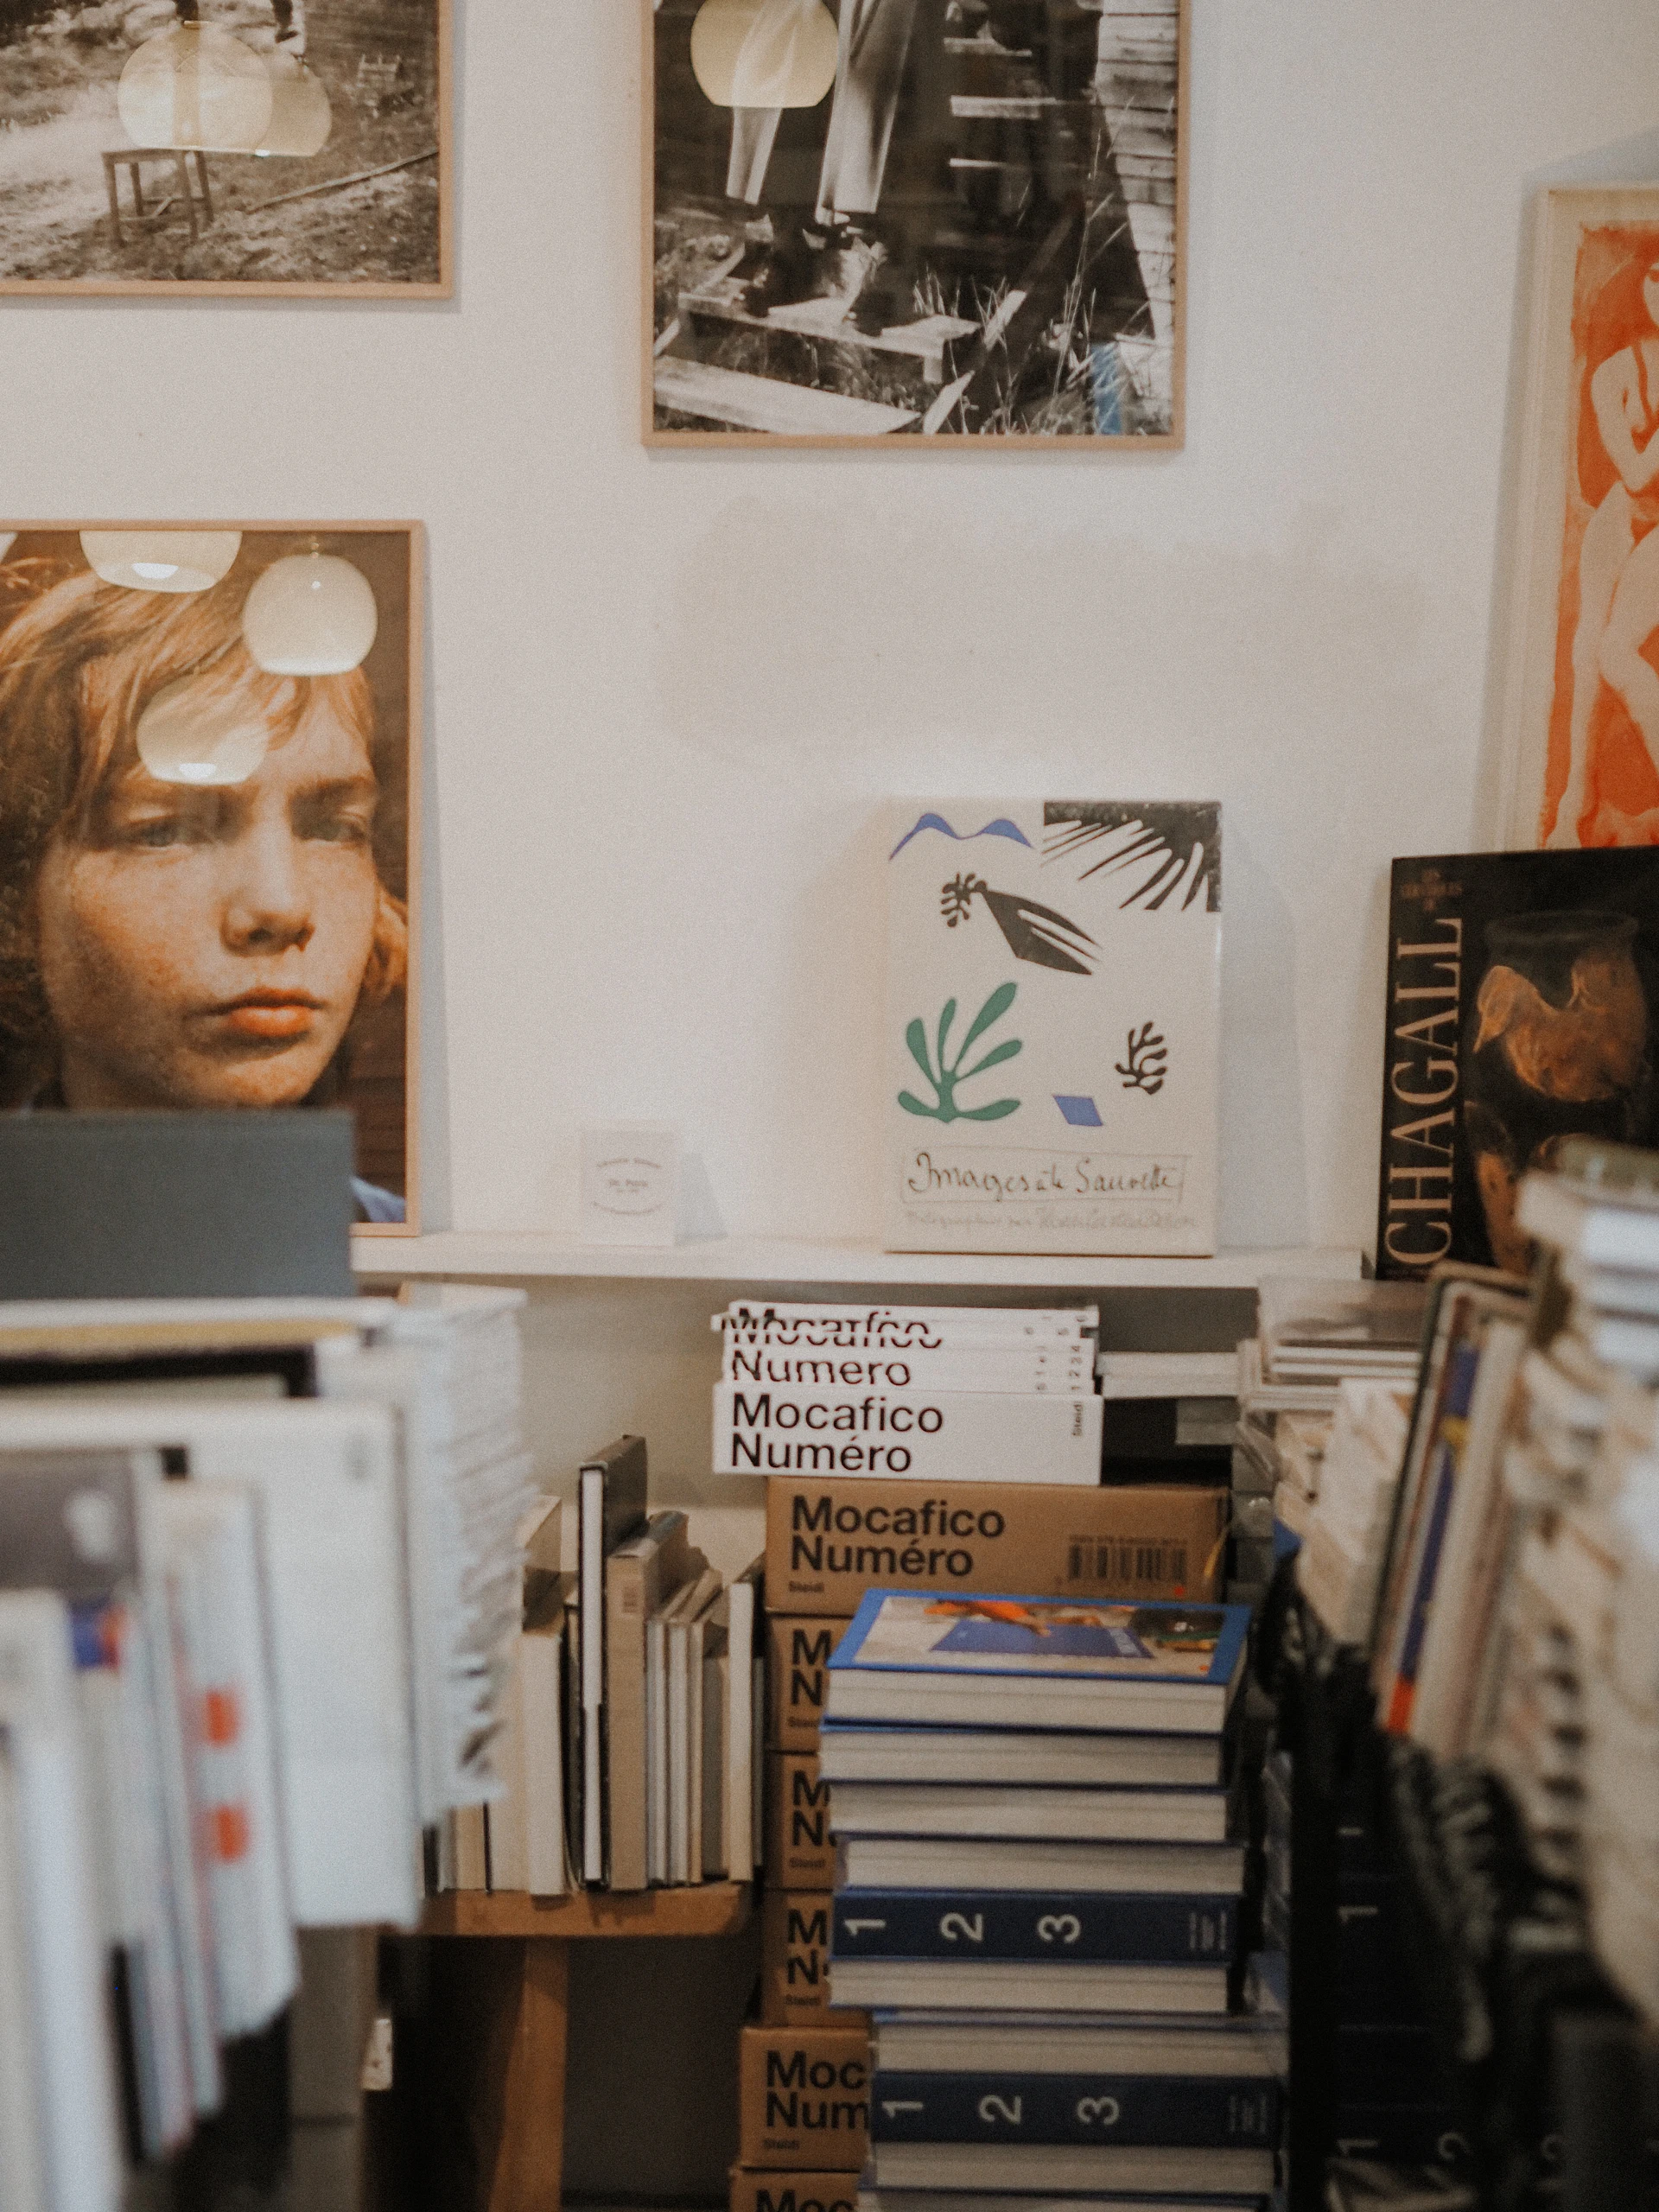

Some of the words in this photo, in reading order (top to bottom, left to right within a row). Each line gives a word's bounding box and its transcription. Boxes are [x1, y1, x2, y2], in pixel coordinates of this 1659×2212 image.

[1385, 918, 1462, 1265] CHAGALL
[734, 1391, 944, 1433] Mocafico
[732, 1432, 912, 1472] Numéro
[791, 1495, 1006, 1538] Mocafico
[791, 1534, 974, 1577] Numéro
[940, 1912, 984, 1942] 2
[1037, 1912, 1082, 1943] 3
[766, 2091, 869, 2130] Num
[977, 2094, 1022, 2125] 2
[1076, 2094, 1120, 2126] 3
